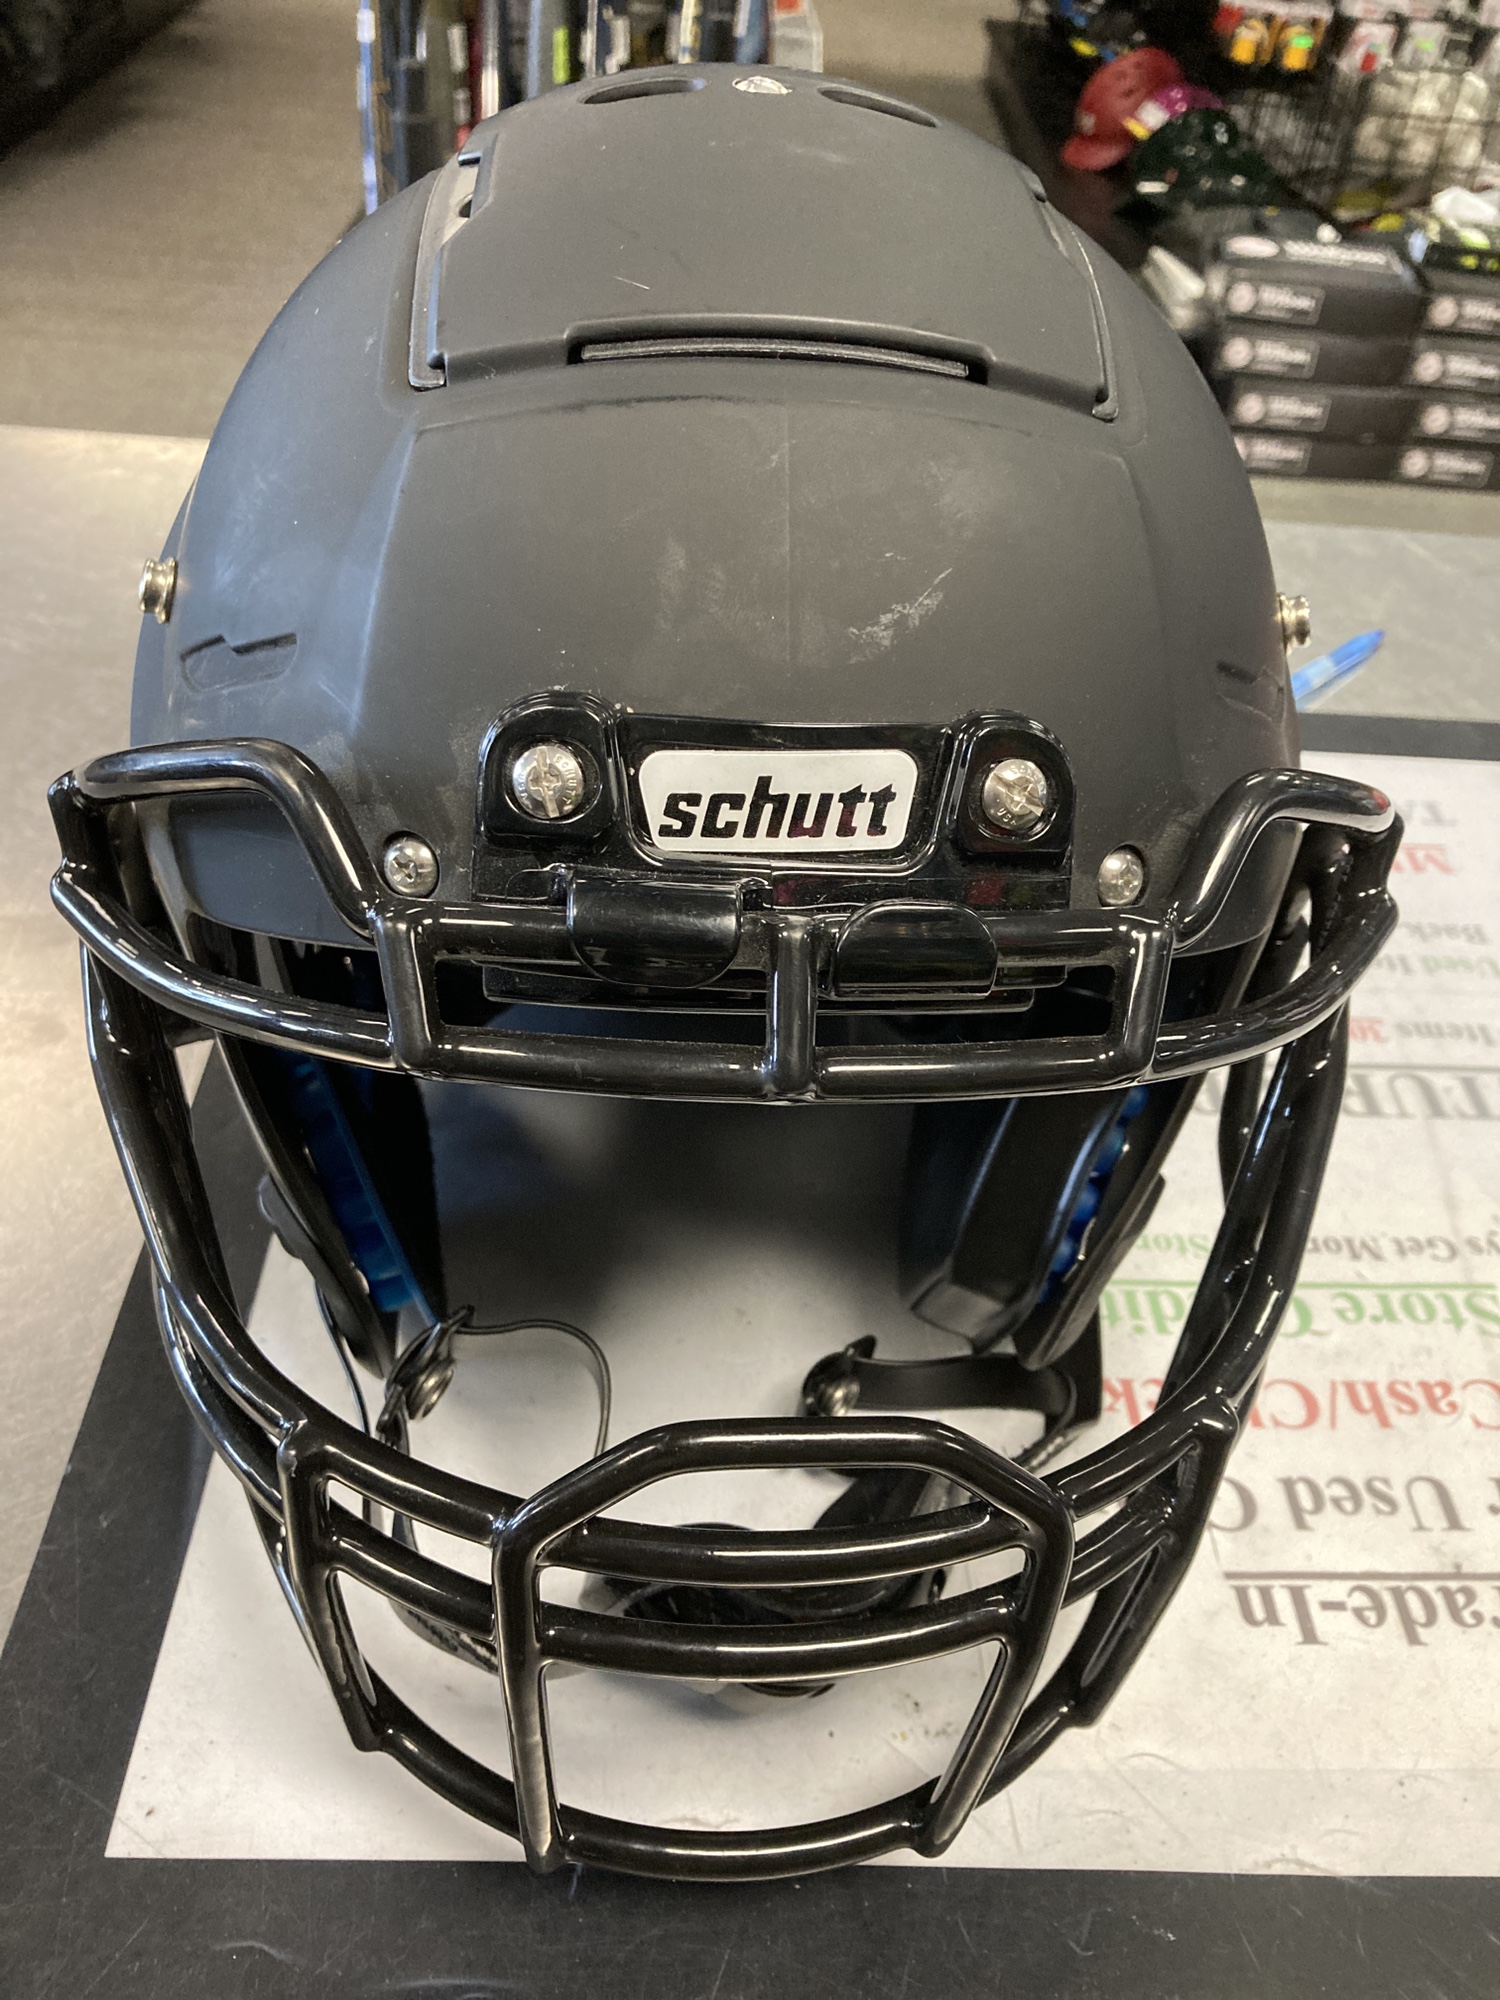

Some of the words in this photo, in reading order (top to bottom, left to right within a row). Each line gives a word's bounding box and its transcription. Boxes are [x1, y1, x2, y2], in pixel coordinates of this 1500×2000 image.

[658, 775, 896, 838] schutt
[1135, 1233, 1212, 1259] Stor
[1304, 1235, 1386, 1263] Mor
[1390, 1235, 1460, 1263] Get
[1334, 1291, 1500, 1338] Store
[1277, 1475, 1470, 1531] Used
